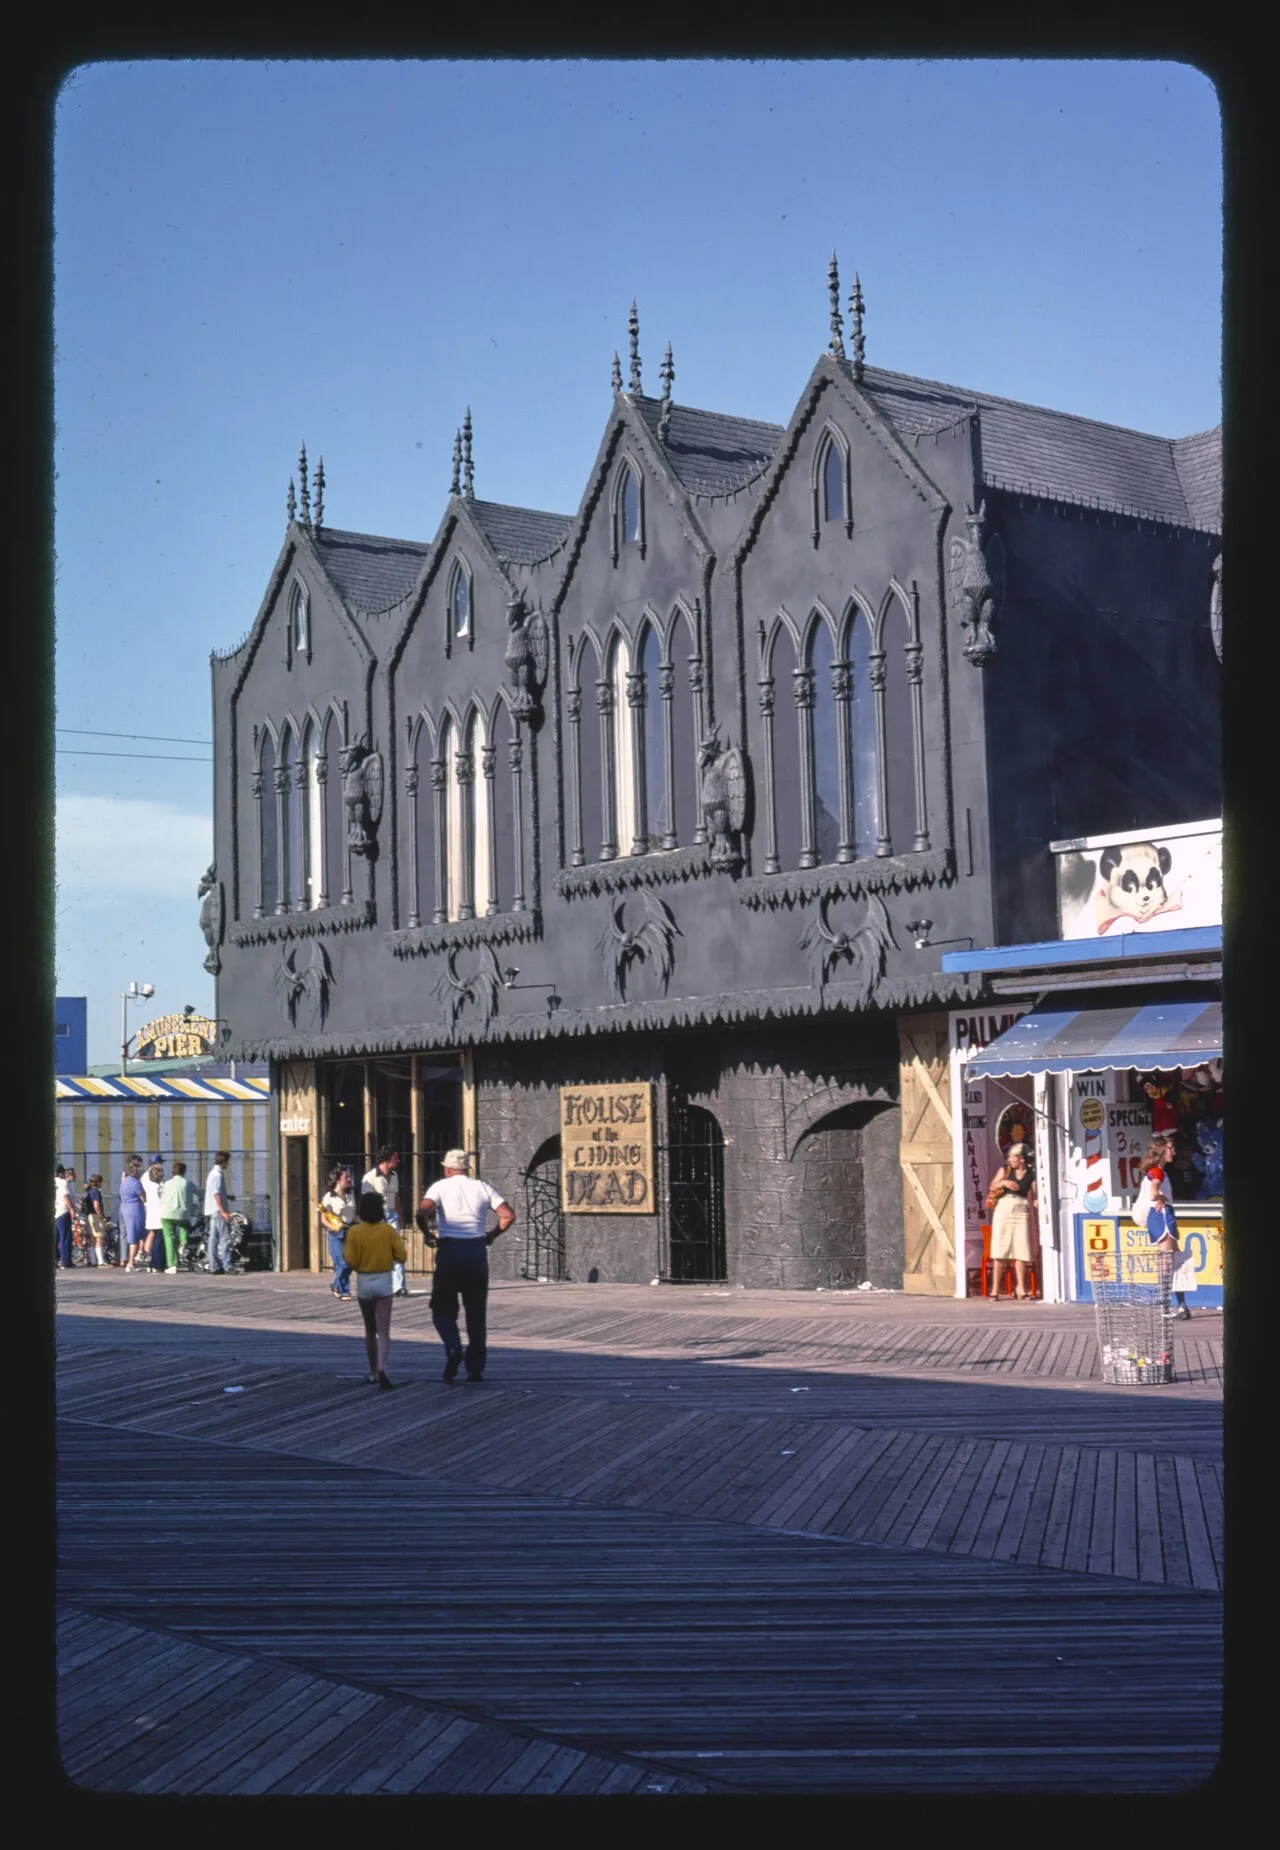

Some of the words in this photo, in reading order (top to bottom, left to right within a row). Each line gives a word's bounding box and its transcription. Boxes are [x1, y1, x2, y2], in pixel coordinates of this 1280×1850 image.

[956, 1012, 1027, 1047] PALM
[153, 1034, 202, 1057] PIER
[1076, 1080, 1105, 1097] WIN
[563, 1094, 646, 1126] HOUSE
[1109, 1109, 1150, 1127] SPECIAL
[280, 1114, 311, 1132] enter
[592, 1128, 602, 1142] of
[605, 1127, 618, 1142] the
[1116, 1132, 1127, 1152] 3
[573, 1144, 642, 1167] LIVING
[565, 1170, 648, 1206] DEAD
